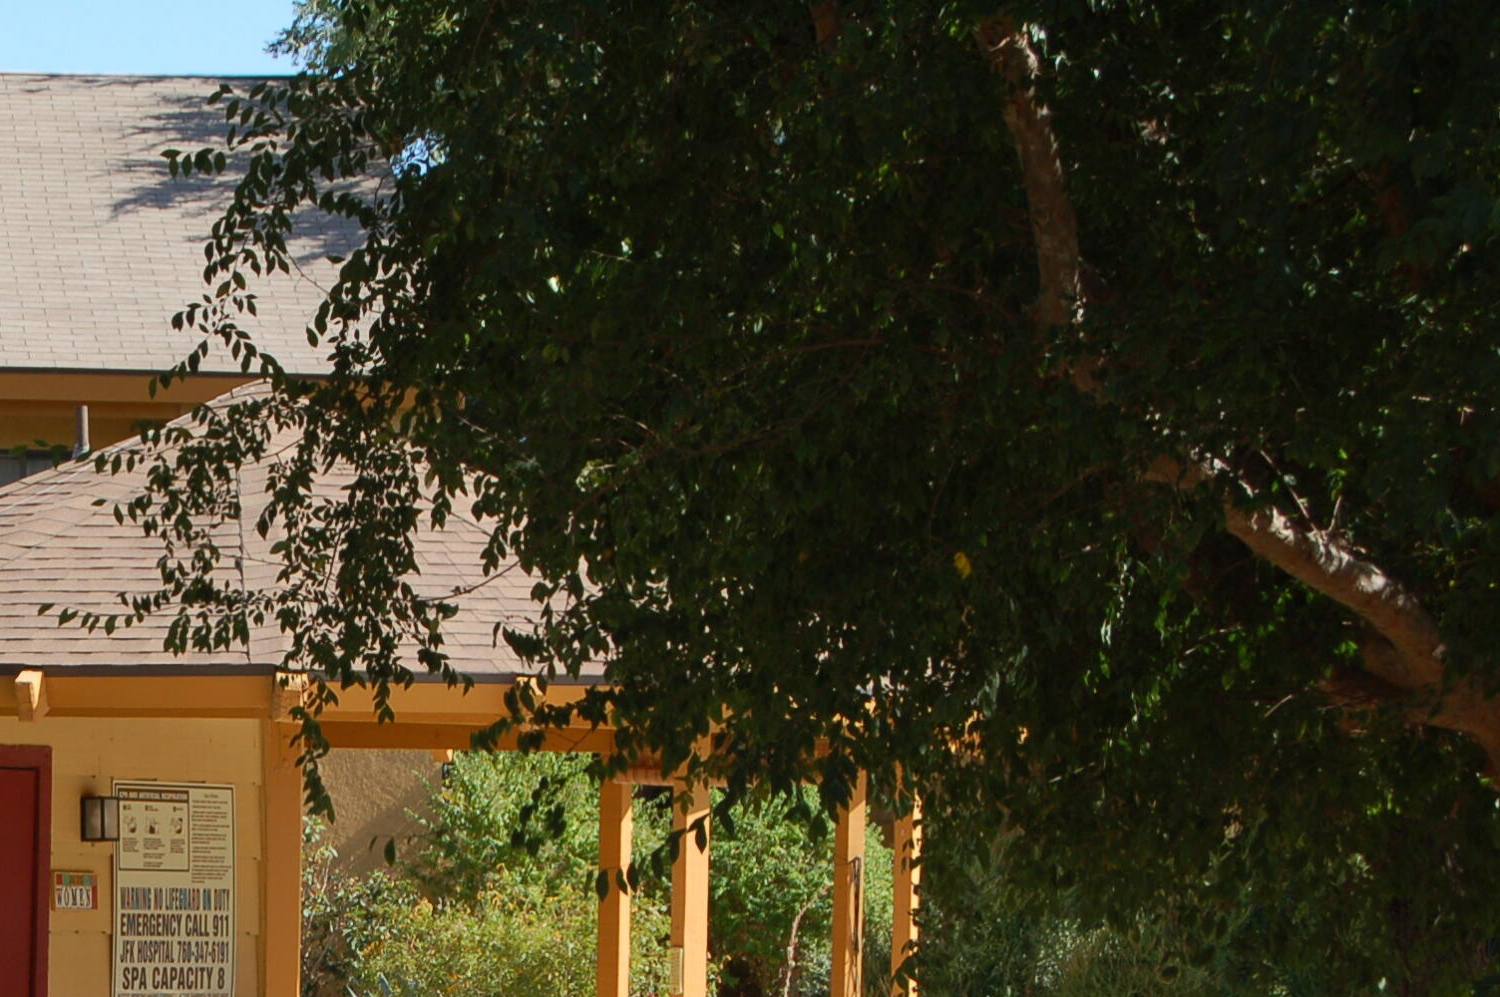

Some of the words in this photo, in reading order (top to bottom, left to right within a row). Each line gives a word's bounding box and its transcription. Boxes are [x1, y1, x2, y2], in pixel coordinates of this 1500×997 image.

[56, 887, 91, 906] WOMEN
[120, 887, 152, 910] WARNING
[153, 887, 163, 910] NO
[165, 887, 200, 911] LIFEGUARD
[202, 888, 212, 911] ON
[213, 888, 230, 911] DUTY
[120, 913, 182, 937] EMERGENCY
[185, 914, 210, 937] CALL
[212, 914, 229, 937] 911
[120, 940, 135, 963] JFK
[137, 940, 175, 963] HOSPITAL
[122, 966, 147, 990] SPA
[152, 966, 214, 990] CAPACITY
[217, 967, 225, 990] 8
